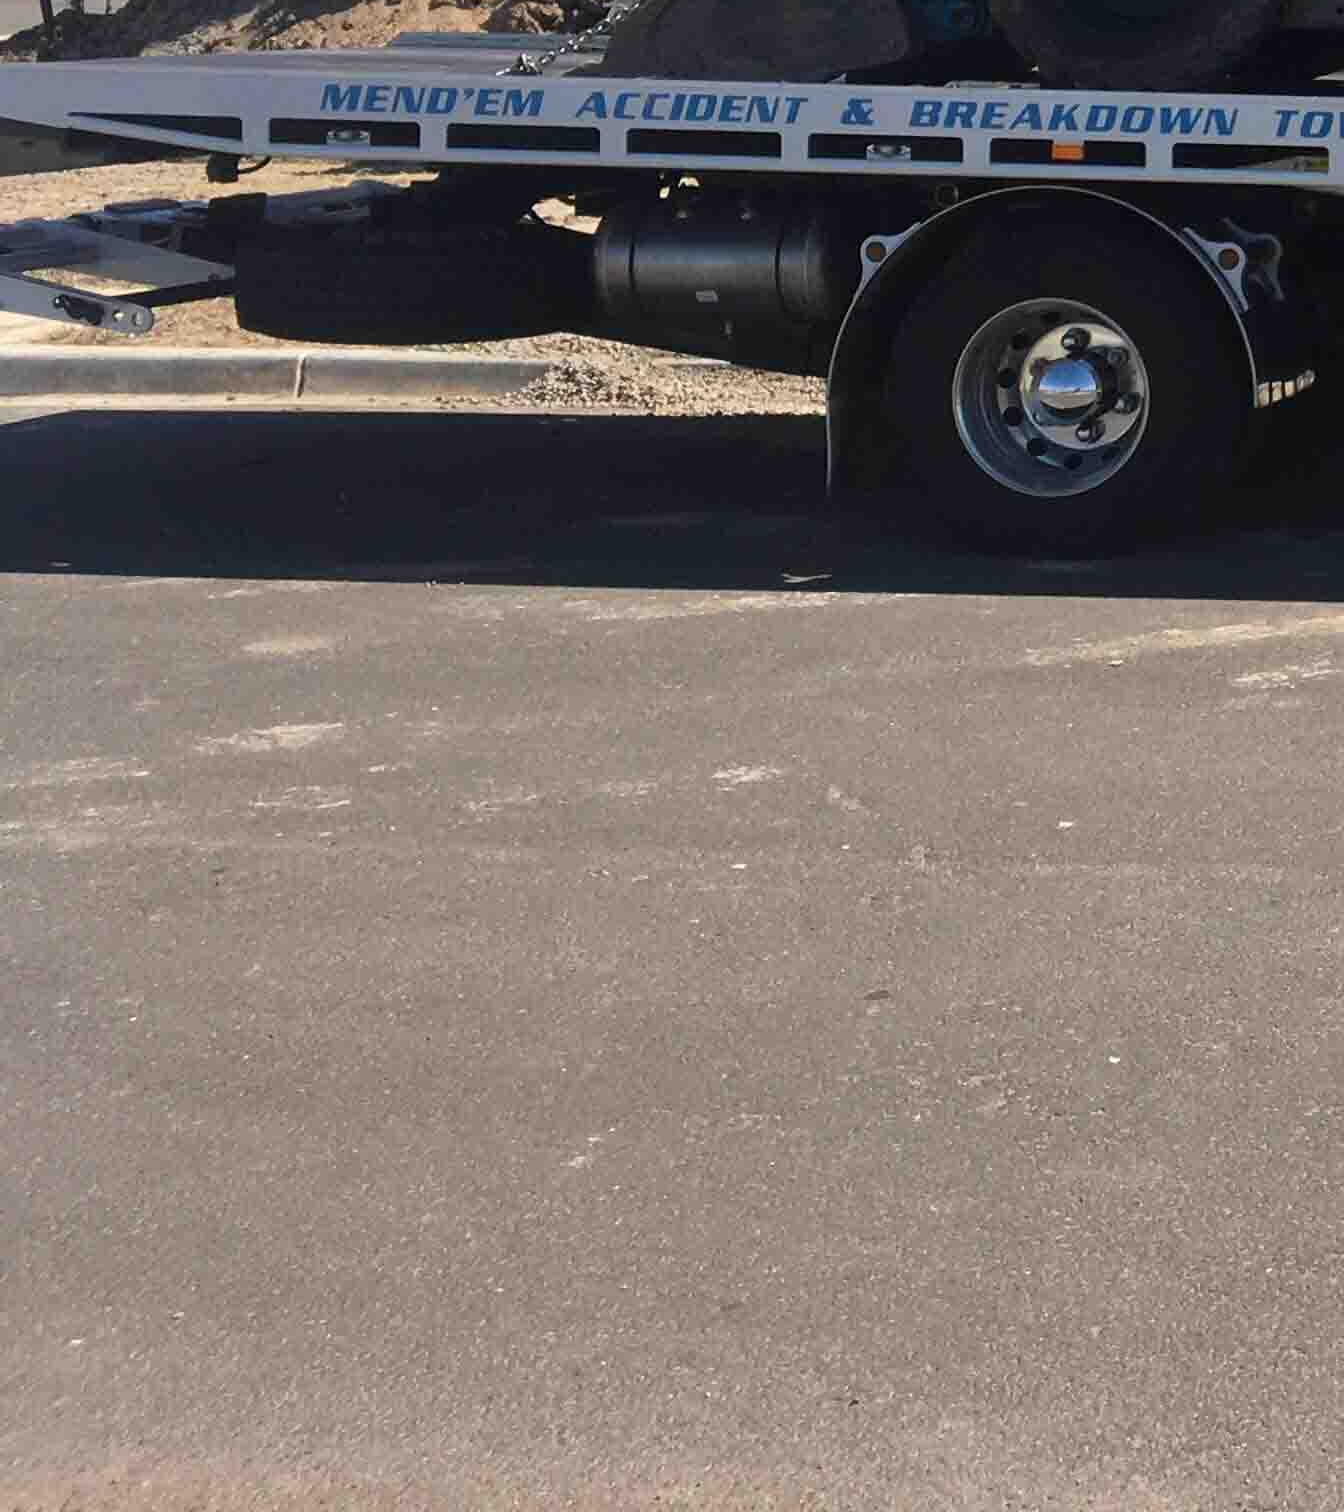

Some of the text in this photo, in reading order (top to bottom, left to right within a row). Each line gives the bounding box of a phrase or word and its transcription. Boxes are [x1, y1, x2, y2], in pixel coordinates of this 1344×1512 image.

[319, 85, 545, 117] MEND'EM
[575, 91, 809, 124] ACCIDENT
[840, 99, 874, 126] &
[909, 101, 1239, 136] BREAKDOWN
